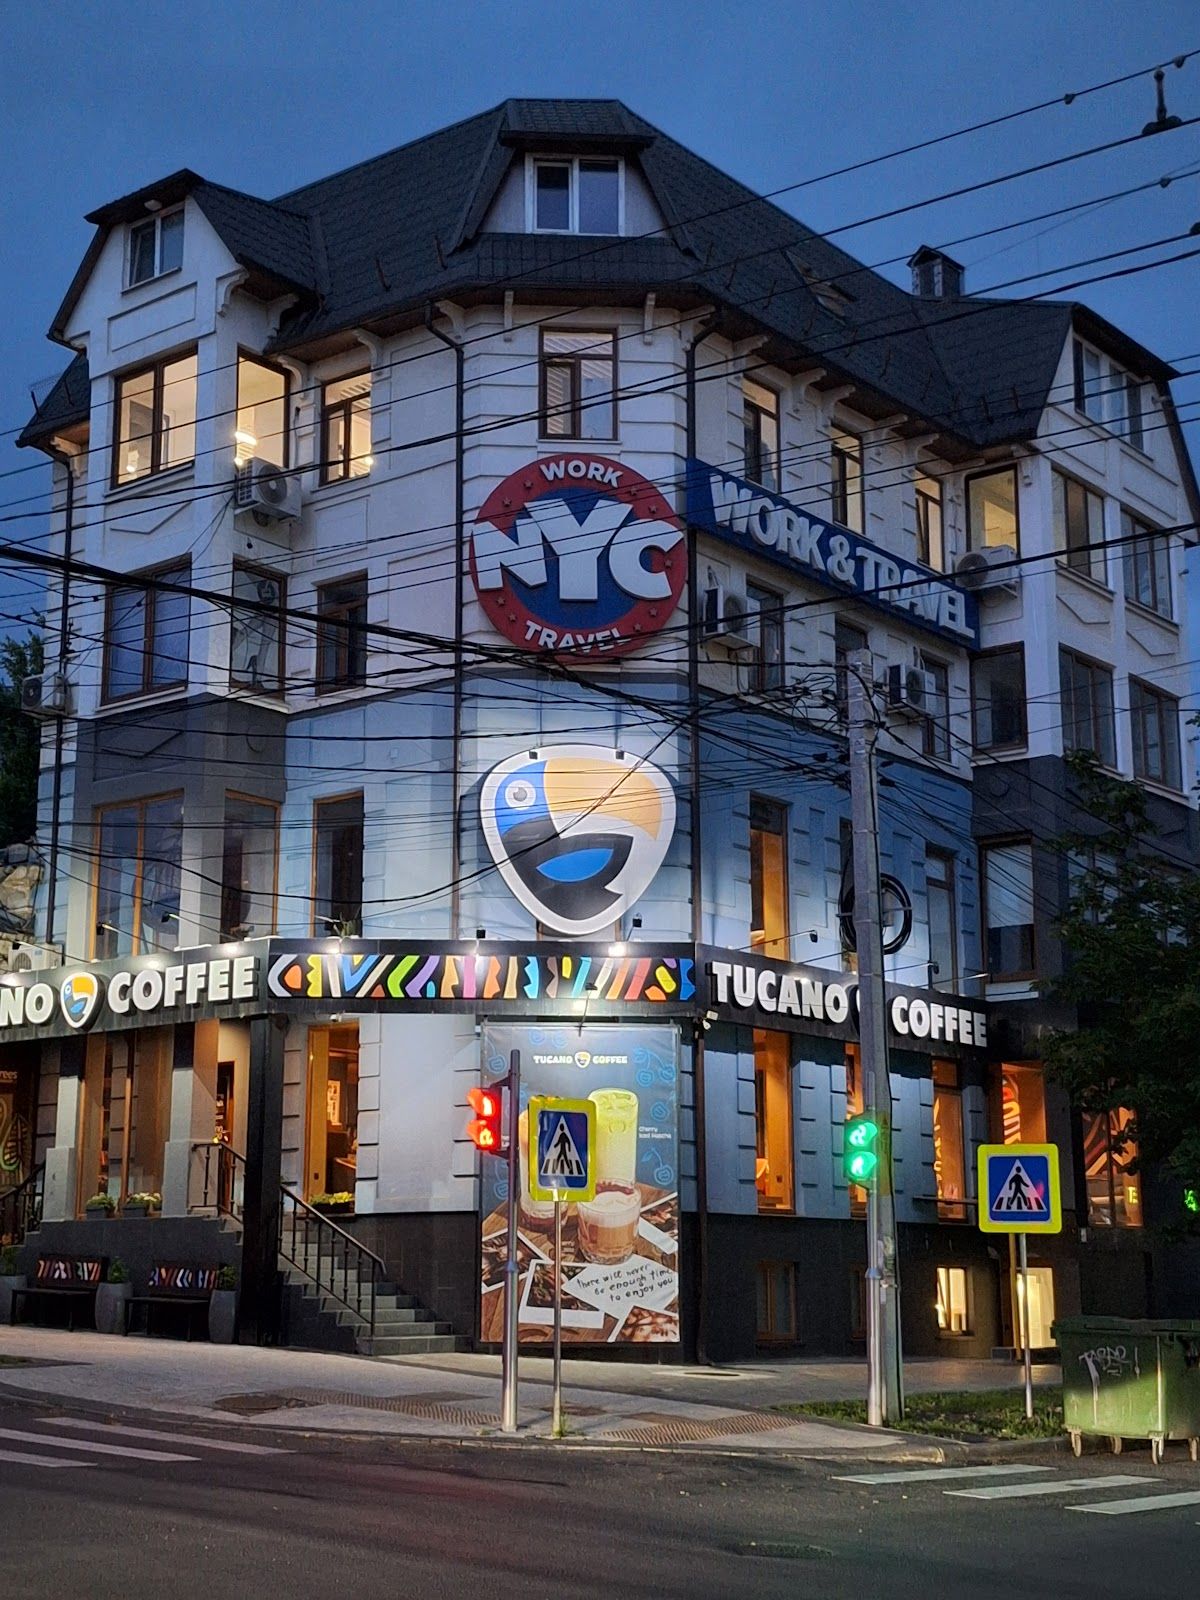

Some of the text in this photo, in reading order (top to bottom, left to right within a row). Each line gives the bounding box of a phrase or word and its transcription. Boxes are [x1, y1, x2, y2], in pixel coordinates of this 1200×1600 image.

[539, 459, 624, 489] WORK
[471, 498, 685, 601] NYC
[709, 473, 976, 640] WORK & TRAVEL
[524, 620, 632, 653] TRAVEL
[0, 955, 259, 1027] NO COFFEE
[709, 960, 988, 1048] TUCANO COFFEE
[533, 1055, 628, 1064] TUCANO COFFEE
[602, 1270, 622, 1282] will
[626, 1263, 651, 1276] never
[609, 1274, 647, 1291] enough
[625, 1285, 654, 1298] enjoy
[657, 1277, 673, 1289] you
